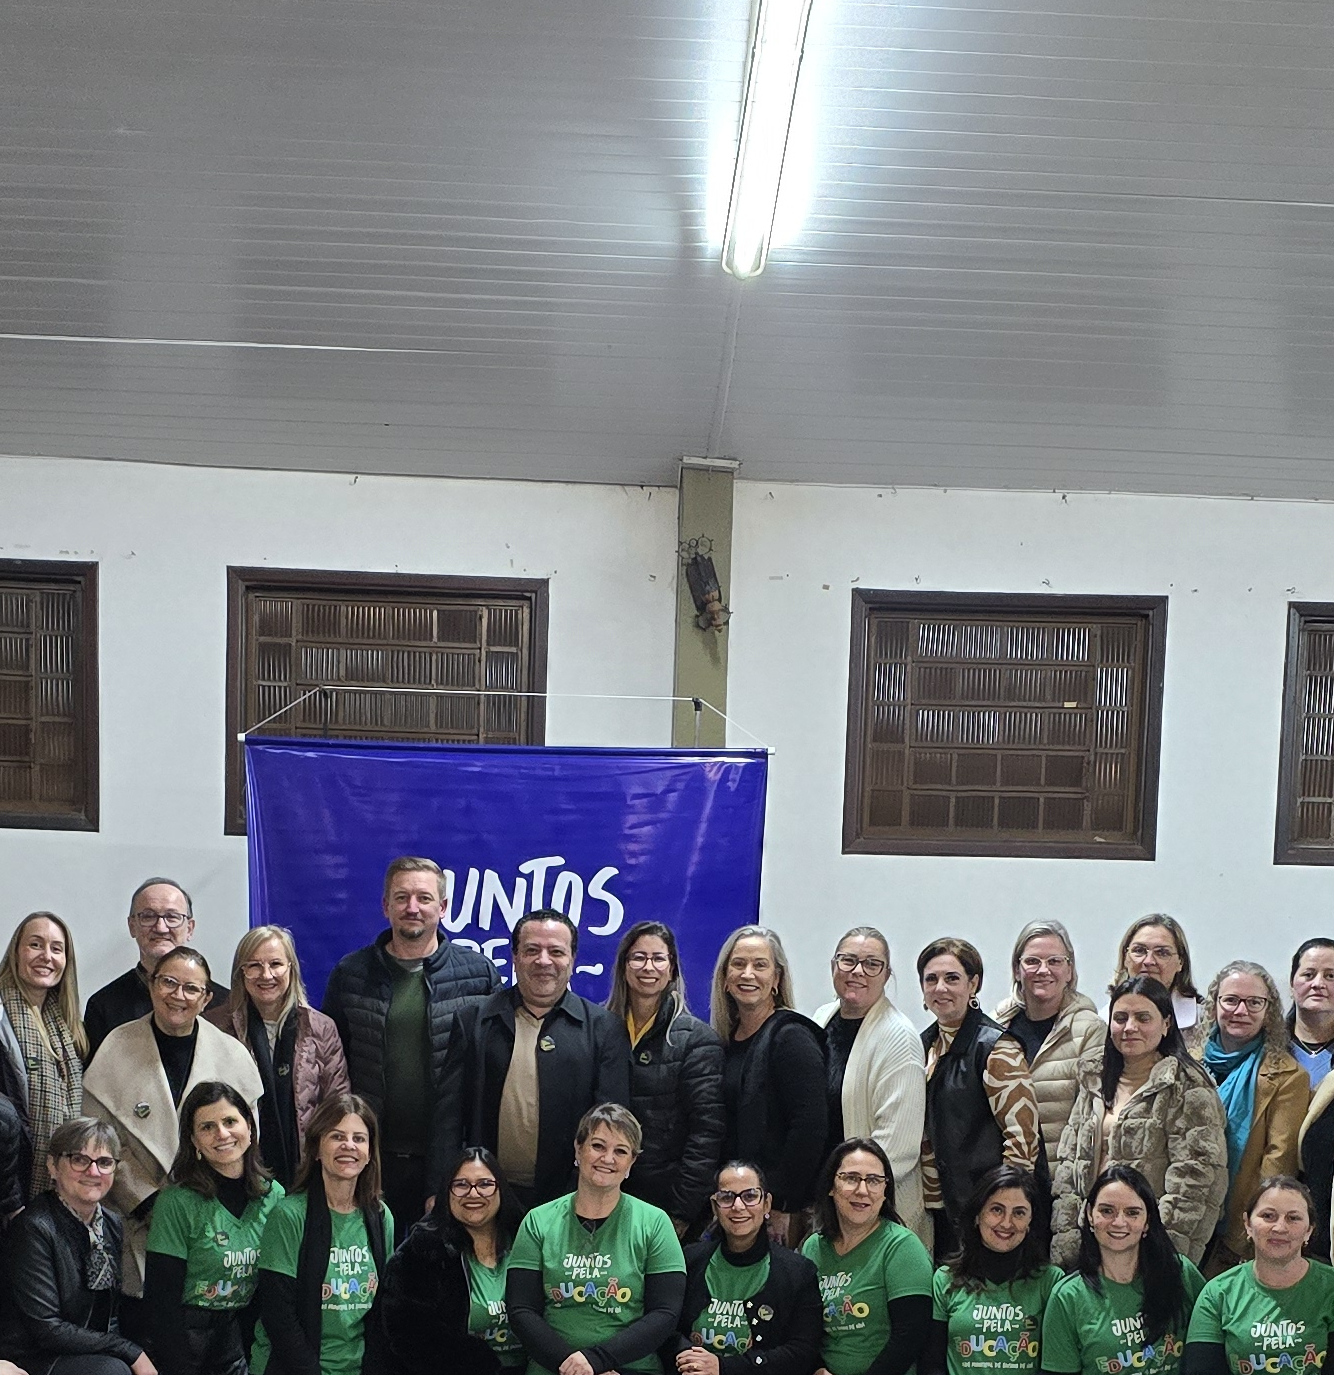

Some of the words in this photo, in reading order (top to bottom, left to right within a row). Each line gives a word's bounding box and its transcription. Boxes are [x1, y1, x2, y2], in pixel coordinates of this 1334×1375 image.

[443, 855, 625, 937] UNTOS
[329, 1245, 370, 1264] JUNTOS
[563, 1252, 612, 1268] JUNTOS
[708, 1298, 747, 1317] JUNTO
[972, 1303, 1024, 1321] JUNTOS
[1250, 1319, 1306, 1338] JUNTOS
[953, 1331, 1039, 1362] EDUCAÇÃO
